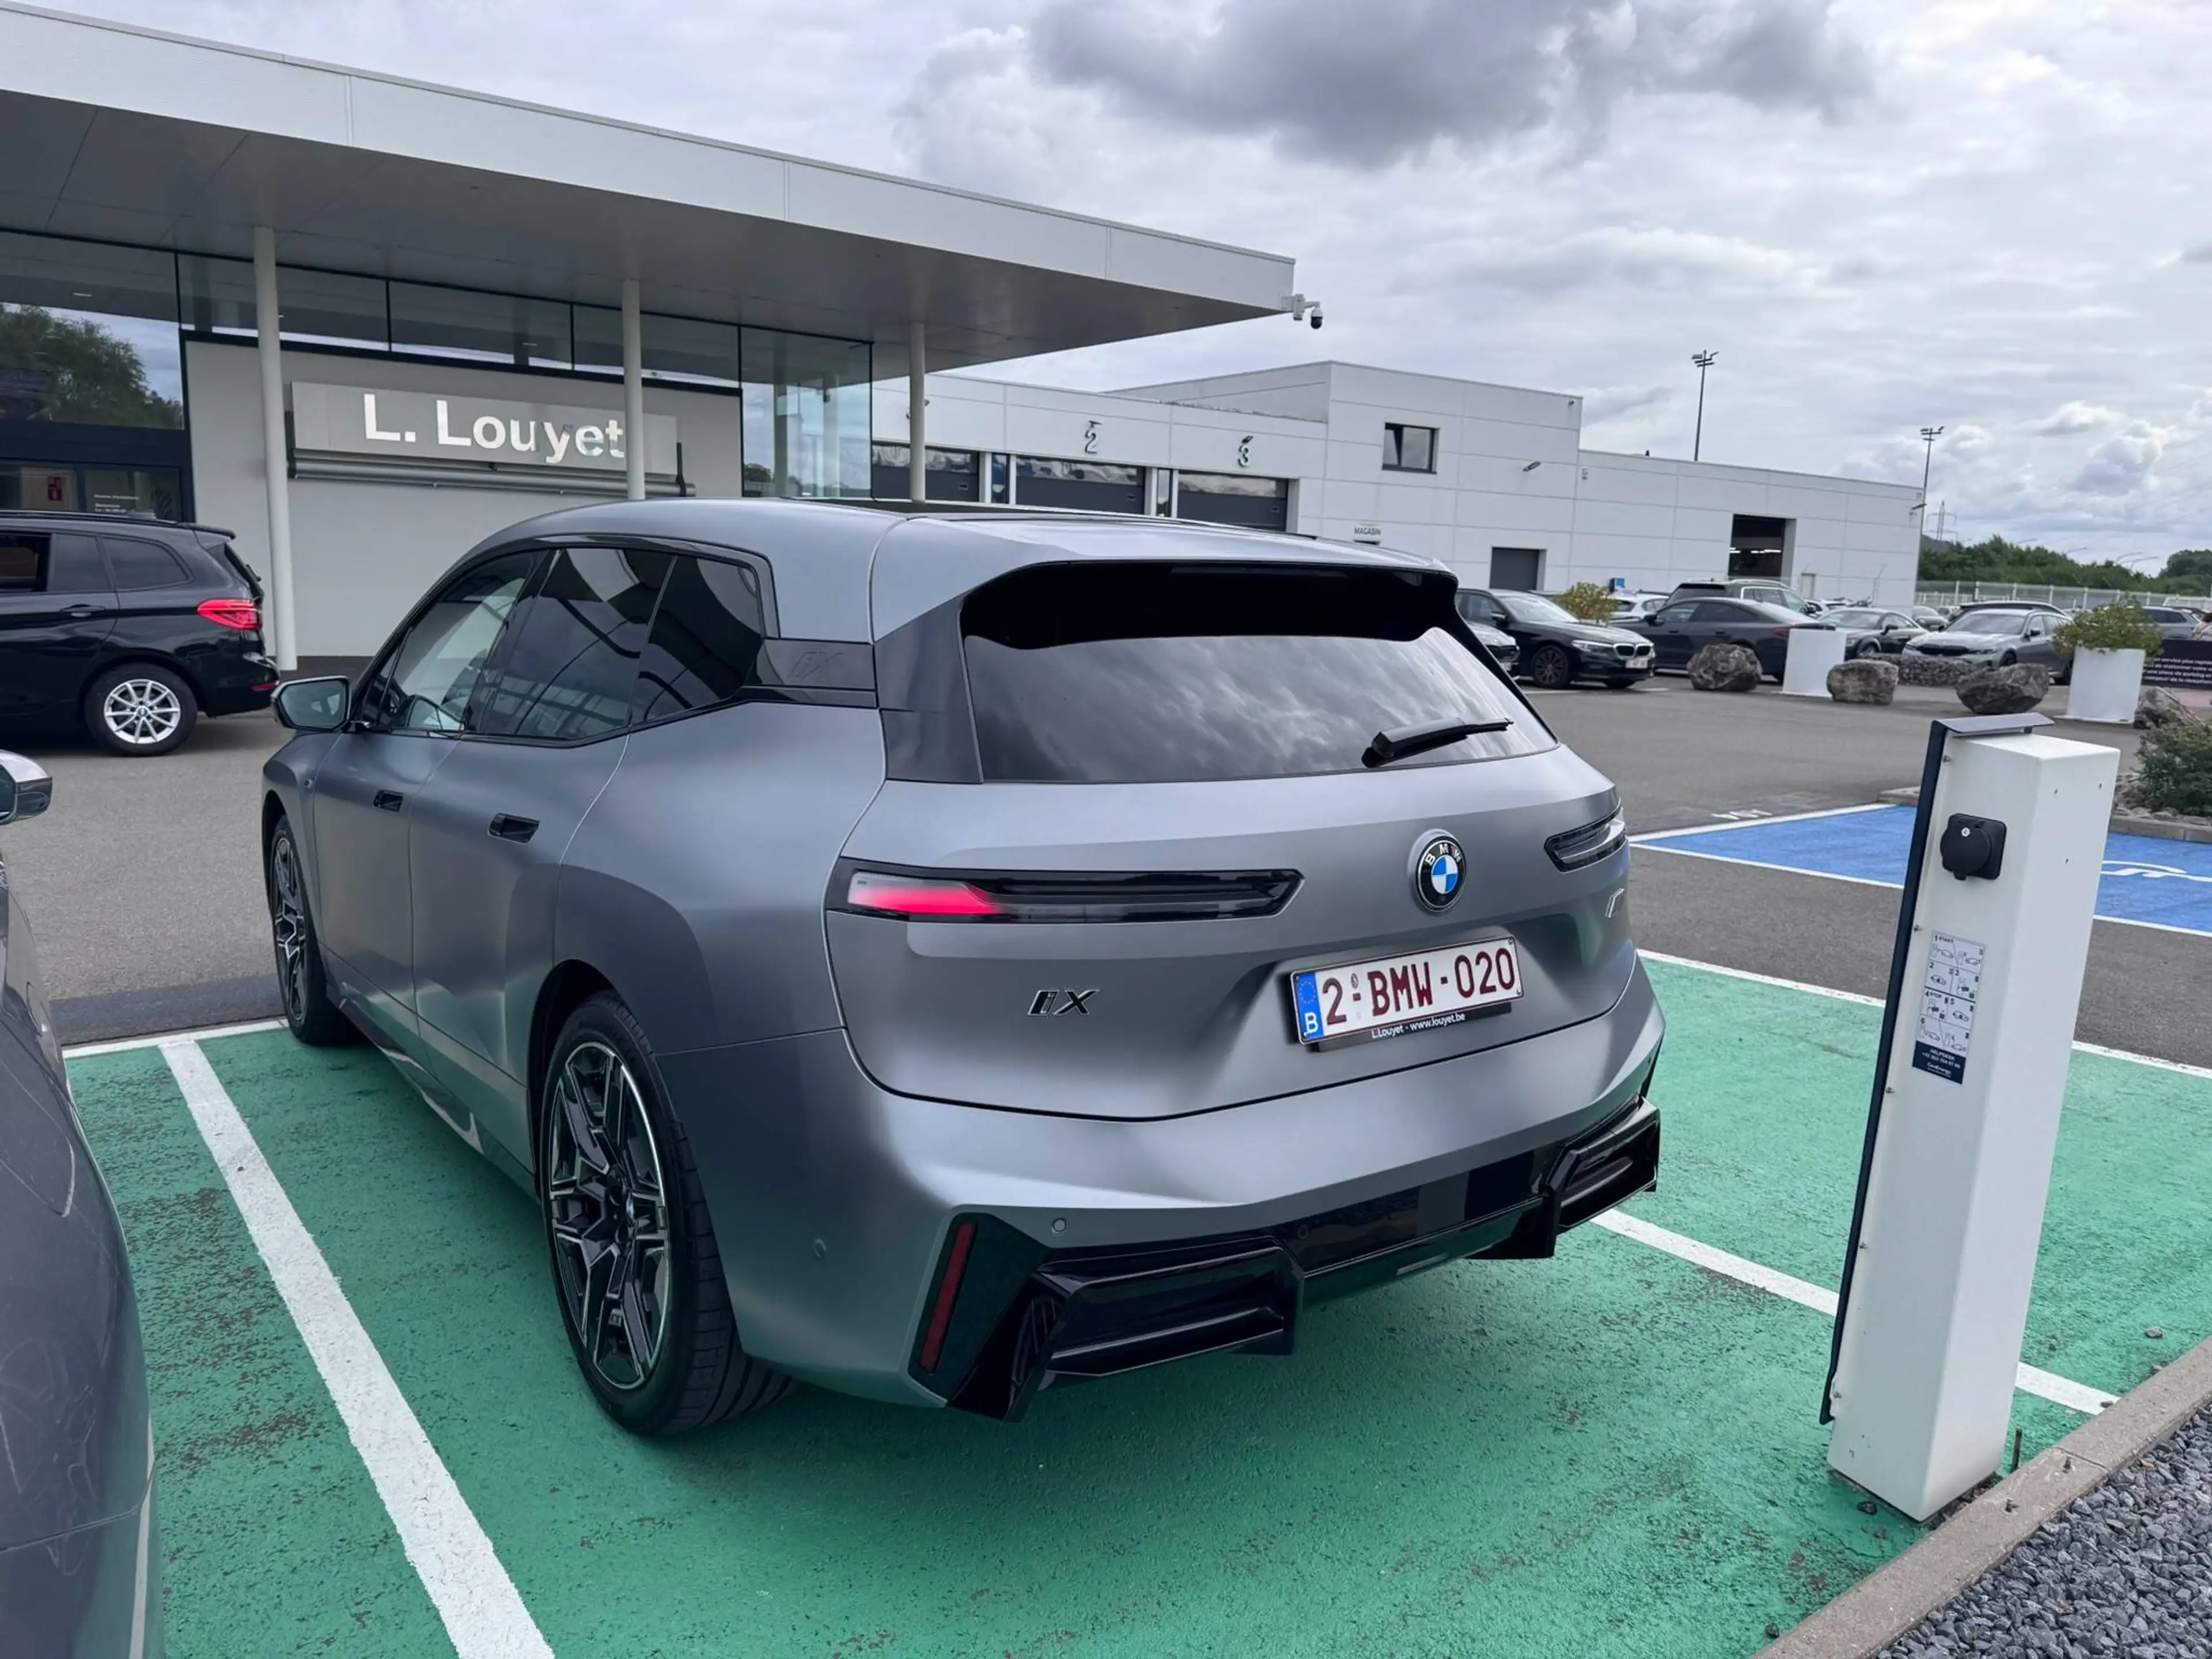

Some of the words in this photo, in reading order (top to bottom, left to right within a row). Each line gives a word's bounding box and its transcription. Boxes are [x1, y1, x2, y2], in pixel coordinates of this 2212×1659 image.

[364, 393, 416, 442] L.
[436, 400, 625, 464] Louyet
[1084, 429, 1098, 454] 2
[1237, 444, 1251, 468] 3
[1425, 843, 1461, 866] BMW
[1304, 1012, 1319, 1033] B
[1410, 1012, 1466, 1031] www.louyet.be
